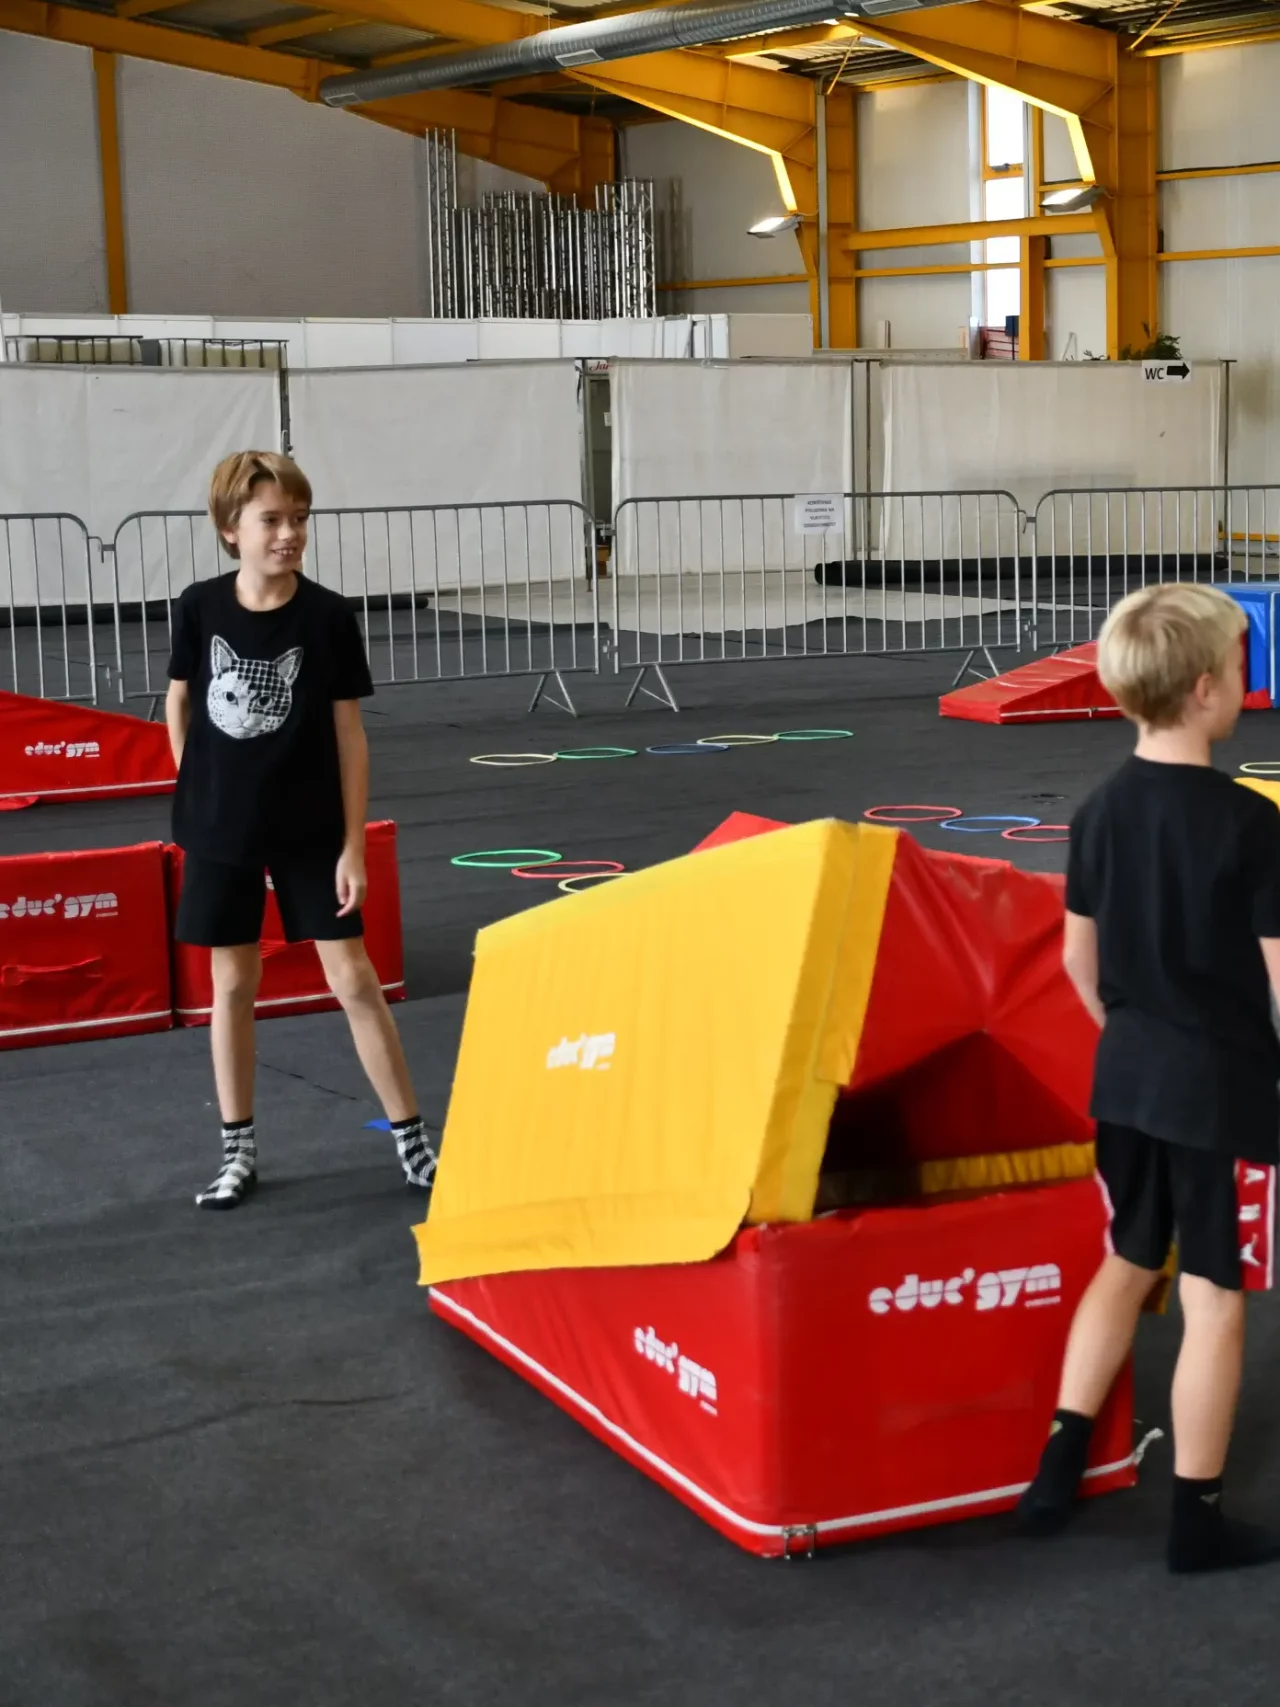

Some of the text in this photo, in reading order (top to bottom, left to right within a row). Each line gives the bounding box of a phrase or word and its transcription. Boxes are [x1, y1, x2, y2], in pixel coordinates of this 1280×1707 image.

[1145, 368, 1164, 380] WC
[25, 741, 100, 758] educ'gym
[869, 1262, 1062, 1314] educ'gym
[634, 1325, 718, 1400] educ'gym
